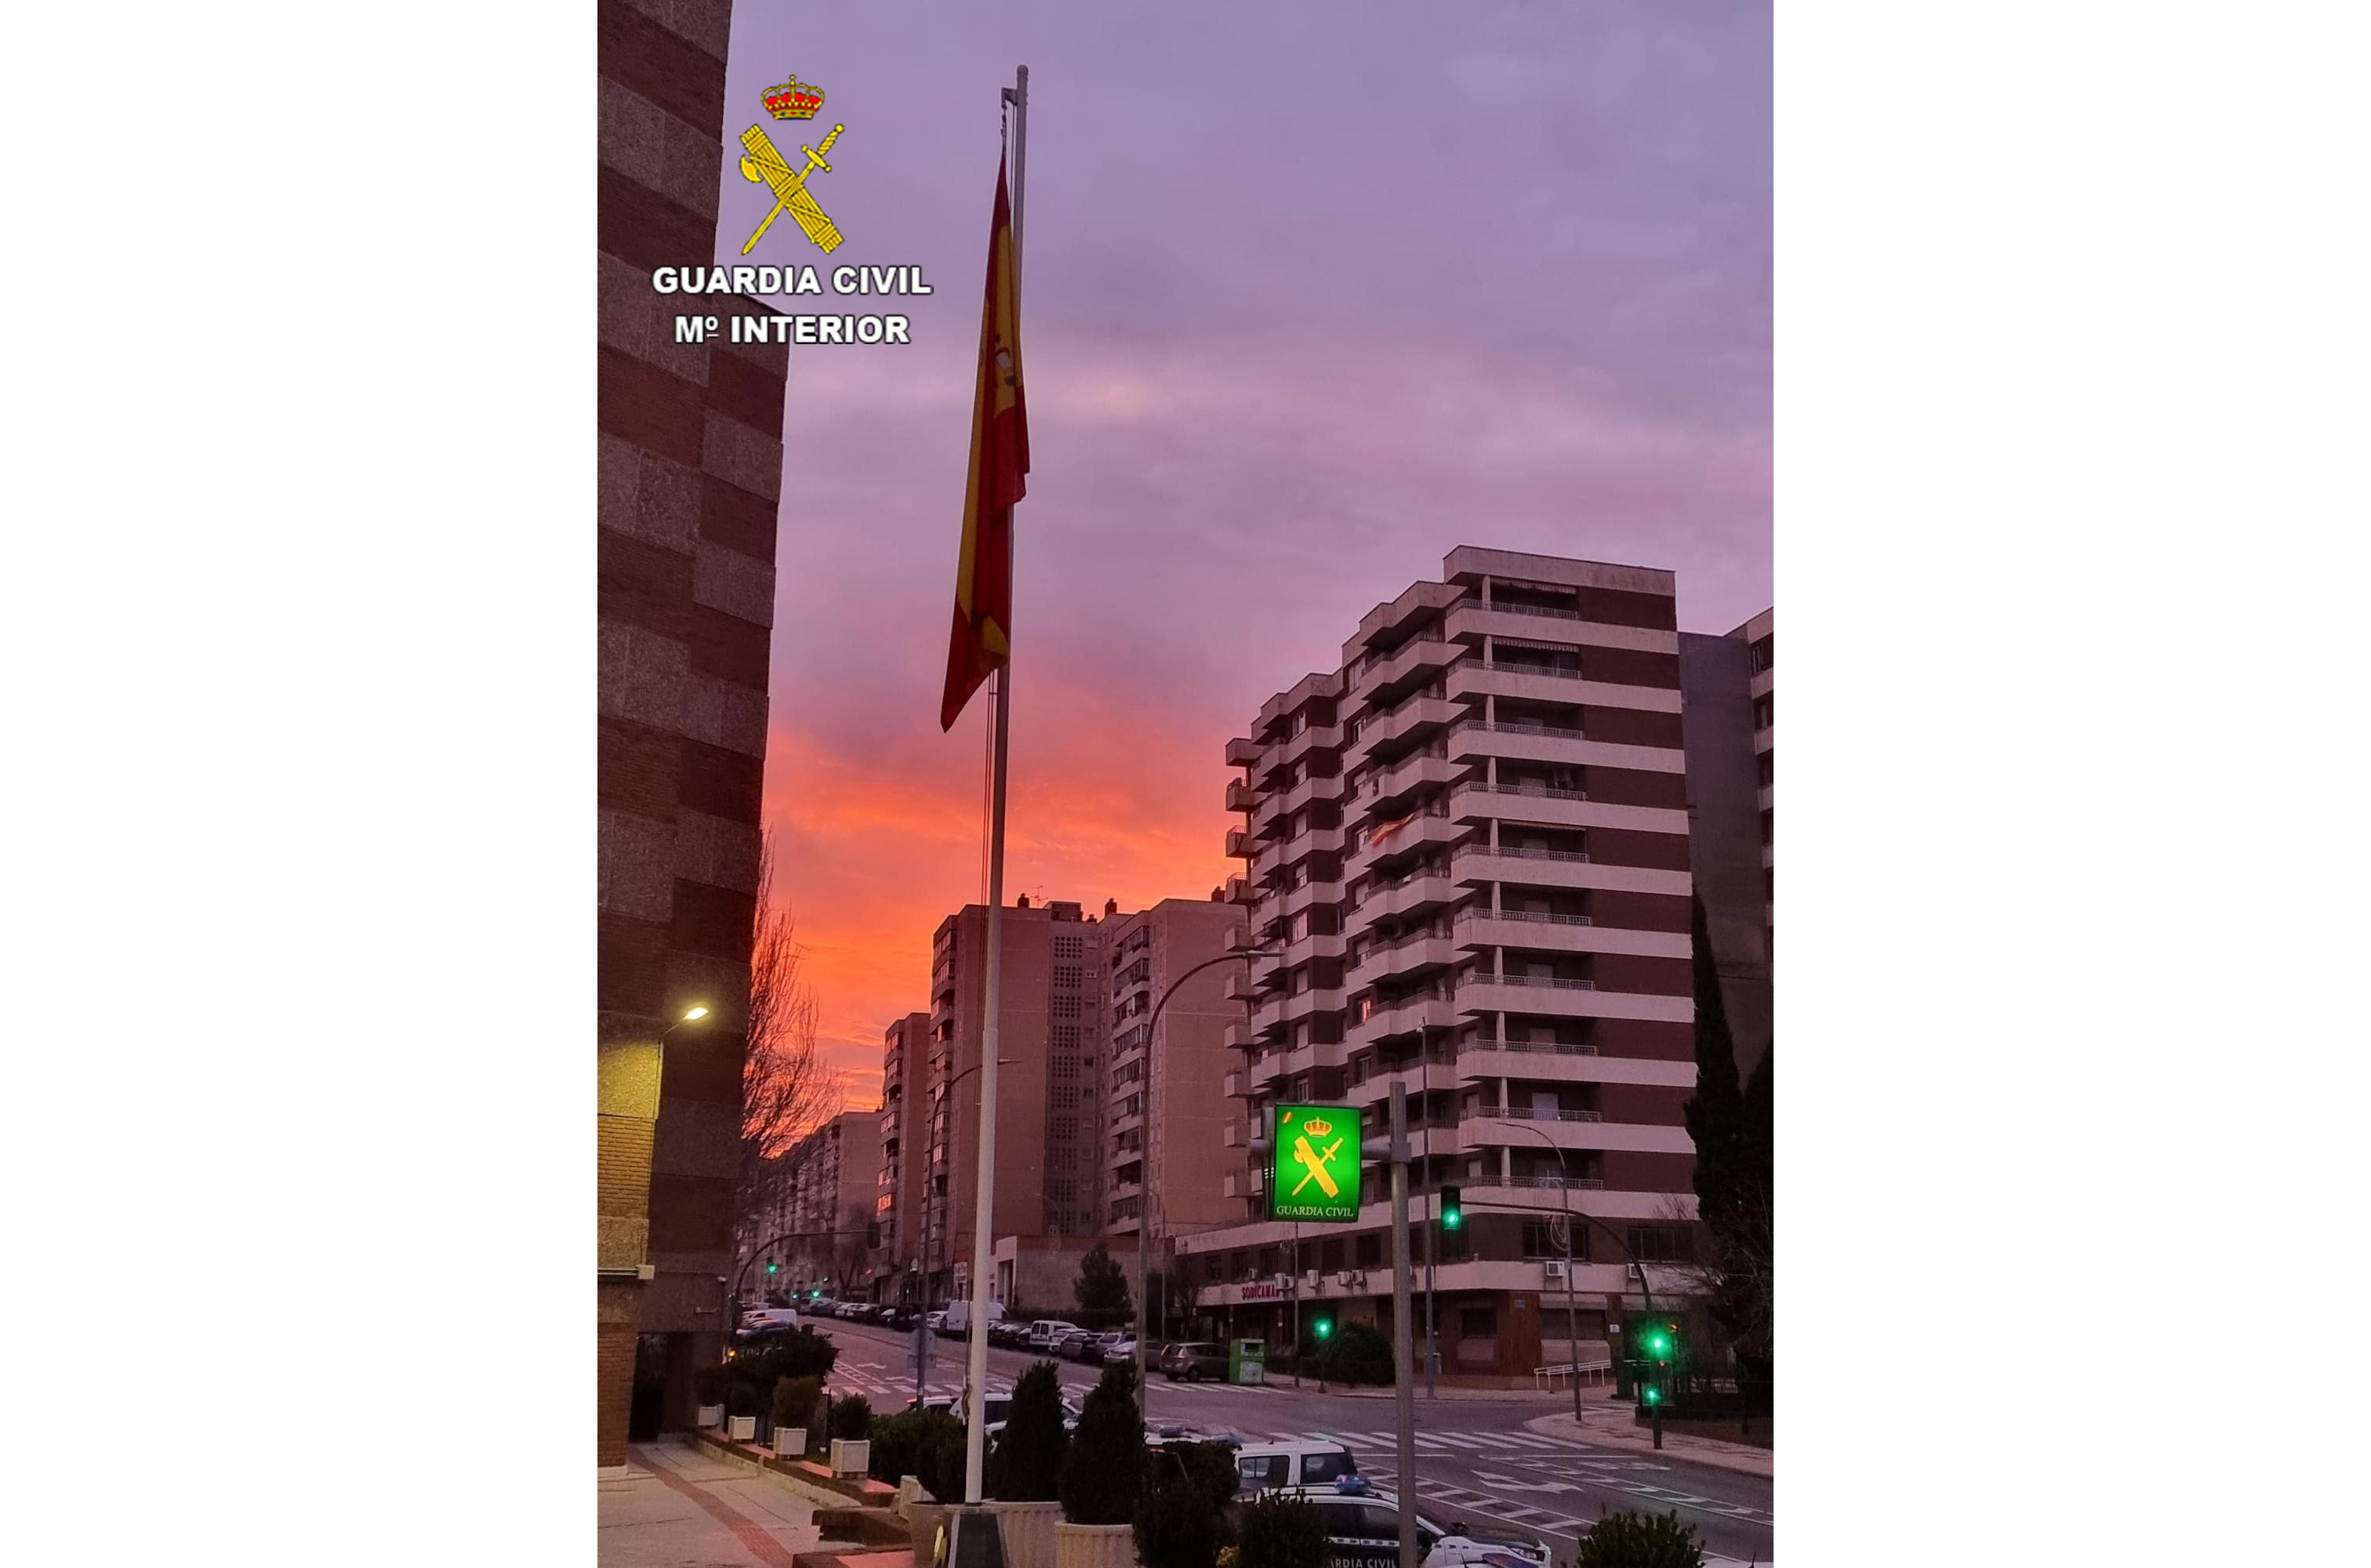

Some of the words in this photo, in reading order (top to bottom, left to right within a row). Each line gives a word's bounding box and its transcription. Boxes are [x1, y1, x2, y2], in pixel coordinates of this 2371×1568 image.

[1276, 1205, 1323, 1216] GUARDIA
[1325, 1207, 1353, 1217] CIVIL
[1367, 1559, 1396, 1568] CIVIL
